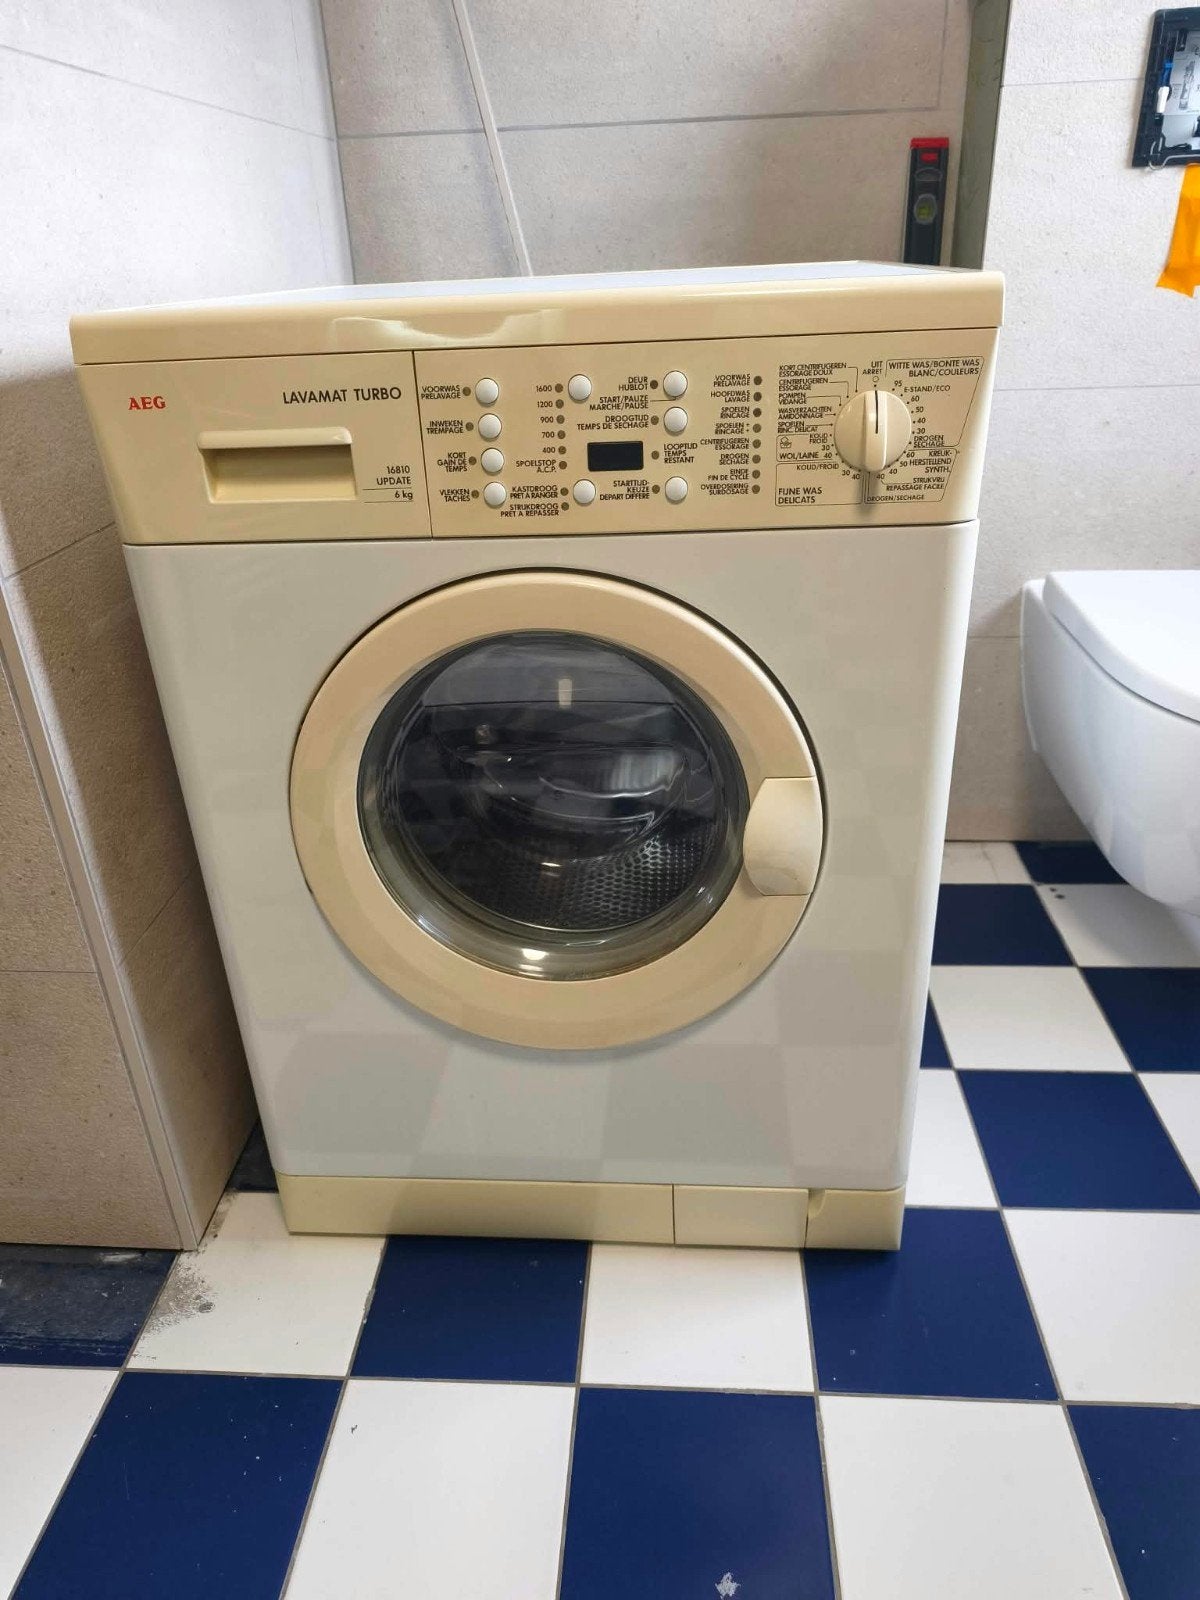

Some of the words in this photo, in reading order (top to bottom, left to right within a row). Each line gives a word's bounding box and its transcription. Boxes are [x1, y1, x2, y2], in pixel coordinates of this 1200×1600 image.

[912, 360, 959, 368] WAS/BONTE
[909, 368, 978, 377] BLANC/COULEURS
[283, 389, 347, 404] LAVAMAT
[354, 387, 401, 401] TURBO
[600, 395, 648, 403] START/PAUZE
[129, 396, 166, 410] AEG
[590, 402, 648, 411] MARCHE/PAUSE
[780, 452, 818, 460] WOL/LAINE
[387, 466, 410, 474] 16810
[376, 477, 411, 486] UPDATE
[402, 490, 413, 500] kg
[778, 496, 815, 504] DELICATS
